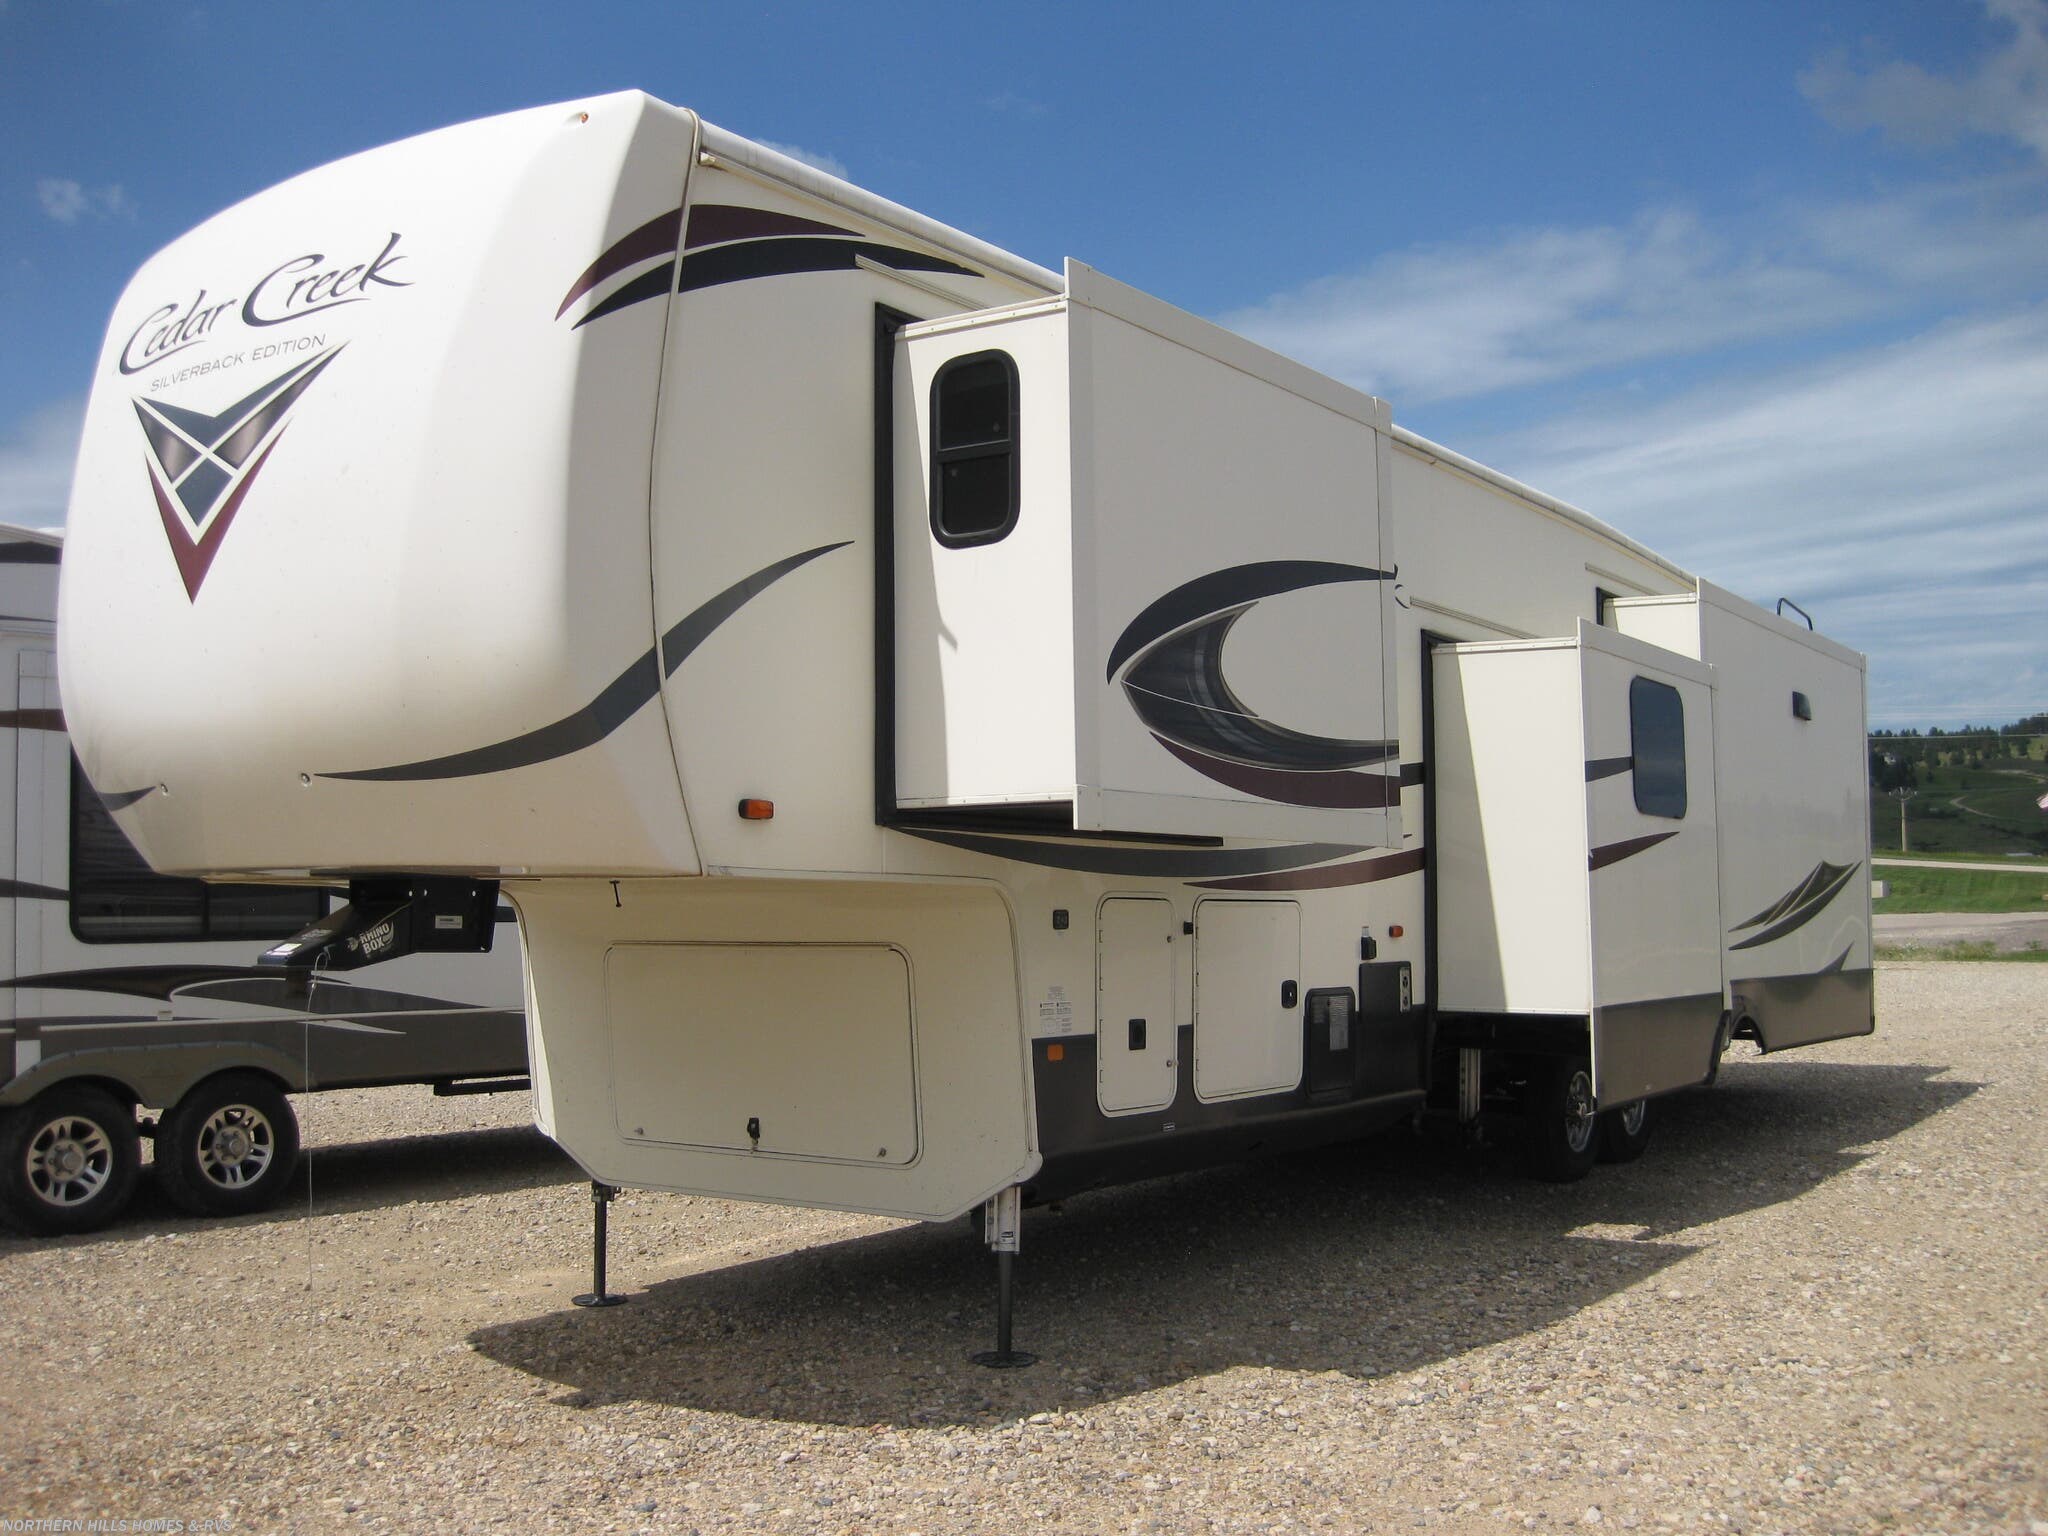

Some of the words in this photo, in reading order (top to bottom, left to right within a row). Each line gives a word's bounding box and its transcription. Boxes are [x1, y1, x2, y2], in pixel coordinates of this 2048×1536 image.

[119, 289, 237, 375] Cedar
[242, 232, 415, 327] Creek
[150, 352, 245, 392] SILVERBACK
[252, 334, 326, 361] EDITION
[363, 937, 385, 954] BOX
